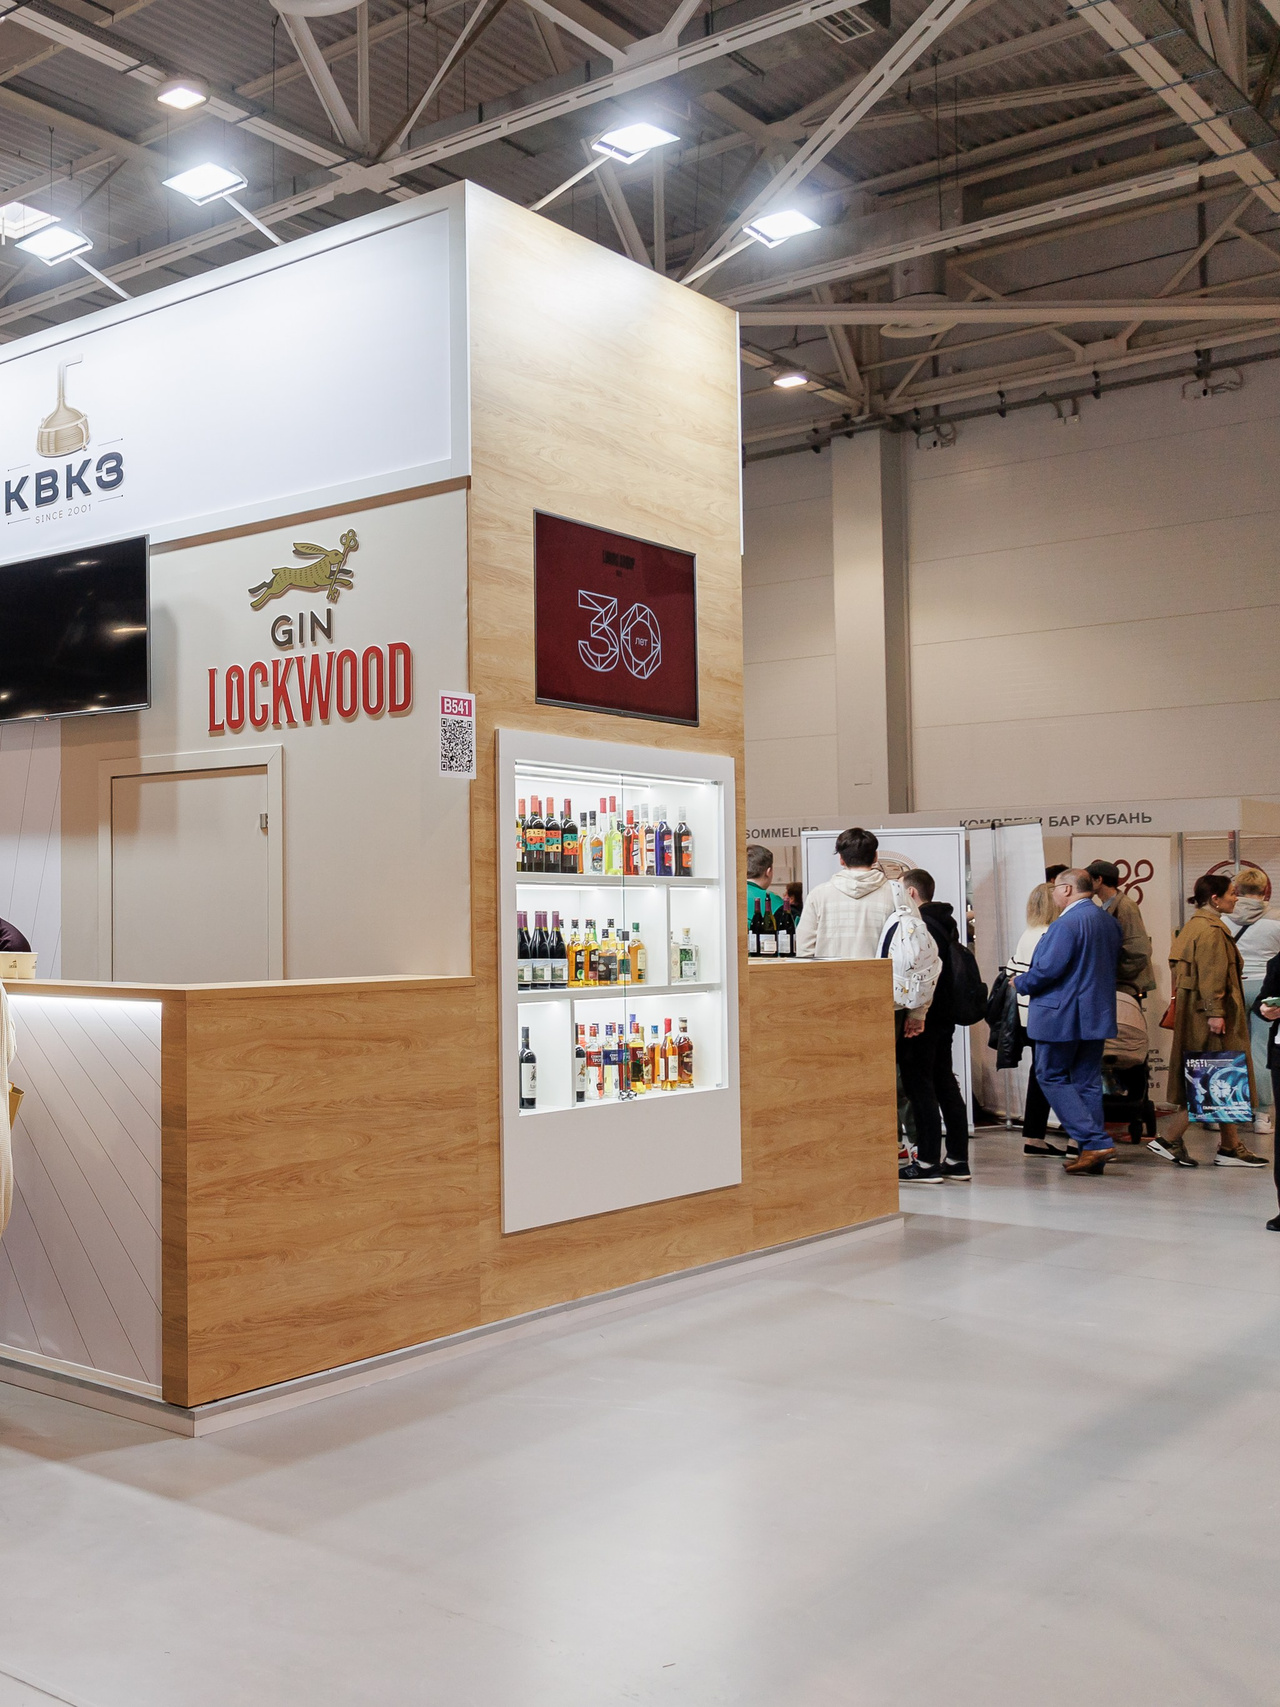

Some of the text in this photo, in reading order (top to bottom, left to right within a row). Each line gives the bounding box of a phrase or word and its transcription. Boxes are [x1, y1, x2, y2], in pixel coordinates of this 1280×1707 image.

[35, 503, 92, 524] SINCE 2001
[270, 607, 332, 647] GIN
[578, 589, 661, 680] 30
[207, 641, 412, 732] LOCKWOOD
[443, 697, 469, 715] B541
[1048, 815, 1080, 827] БАР
[1085, 812, 1152, 826] КУБАНЬ
